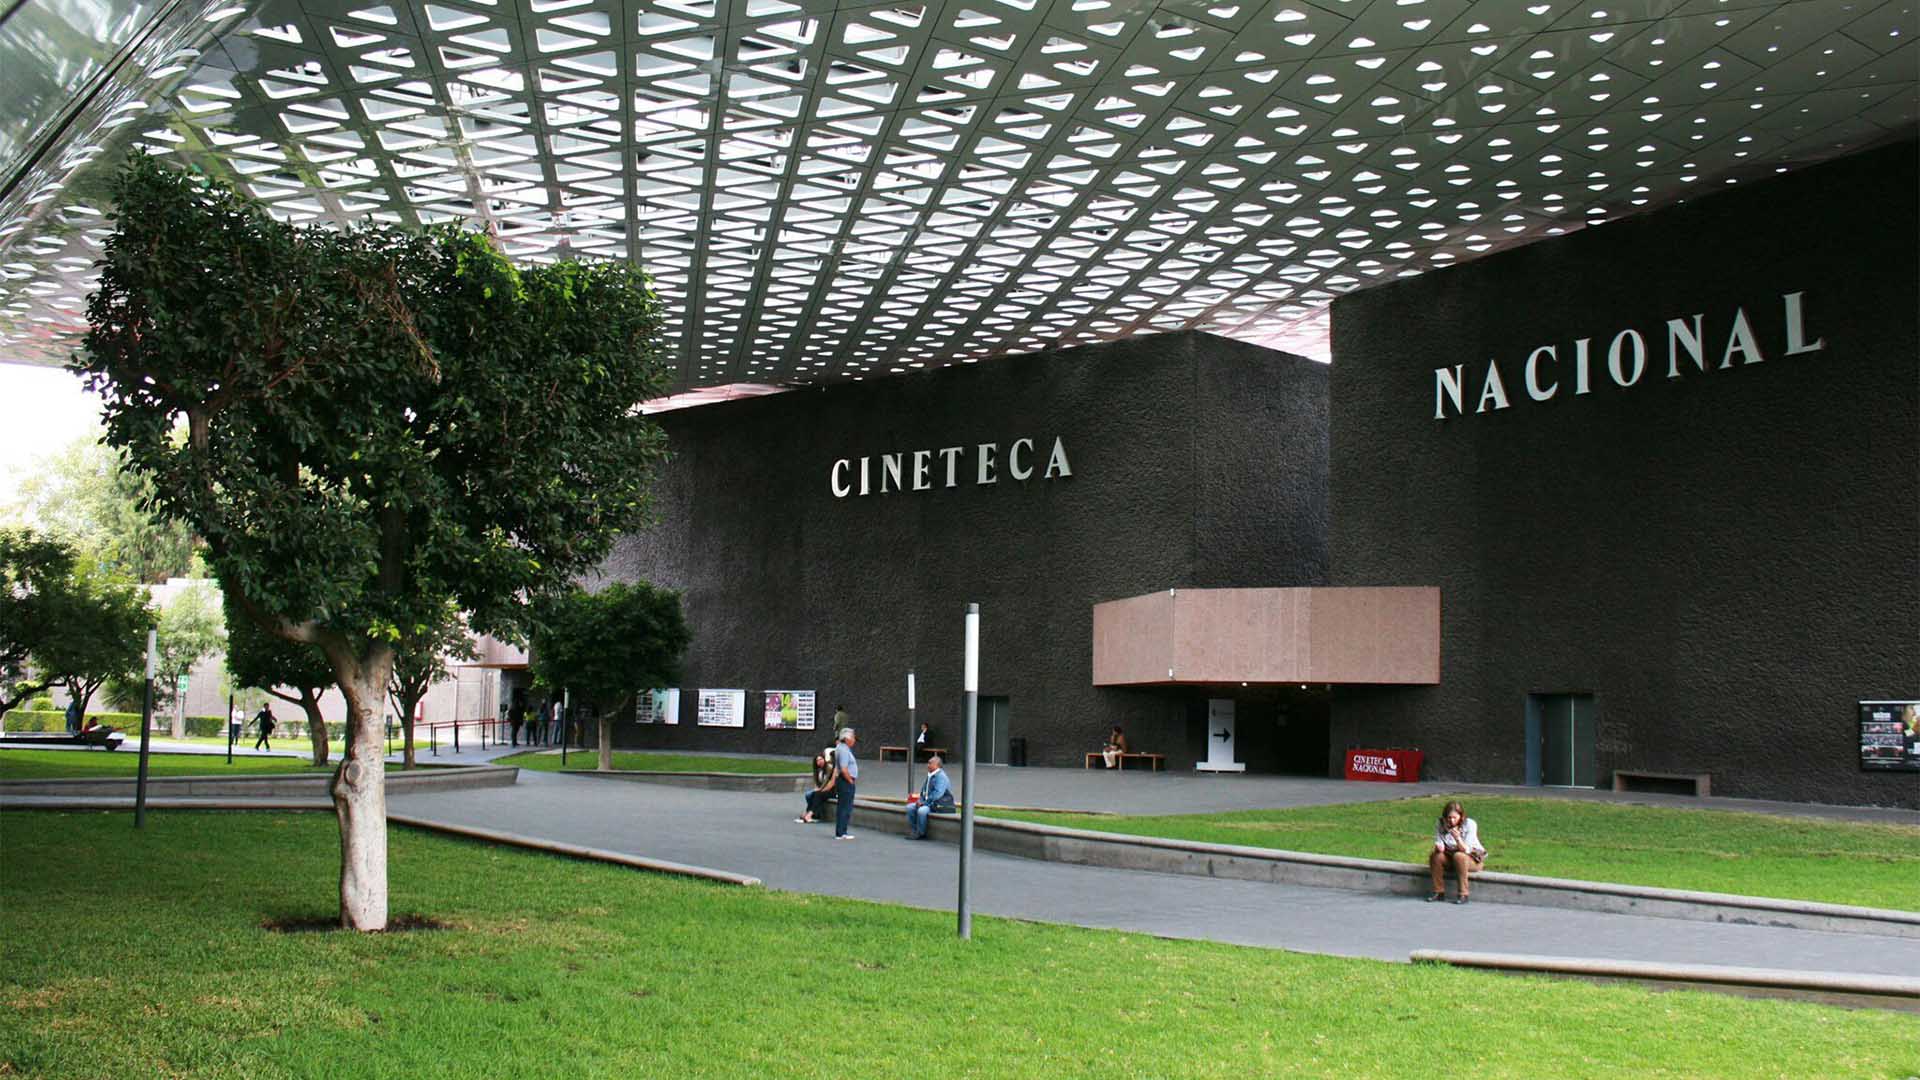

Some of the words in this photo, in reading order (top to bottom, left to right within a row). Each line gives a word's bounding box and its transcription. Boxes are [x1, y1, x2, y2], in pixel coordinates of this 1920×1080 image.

[1434, 291, 1824, 420] NACIONAL
[831, 435, 1073, 498] CINETECA
[1353, 755, 1387, 766] CINETECA
[1353, 763, 1386, 775] NACIONAL
